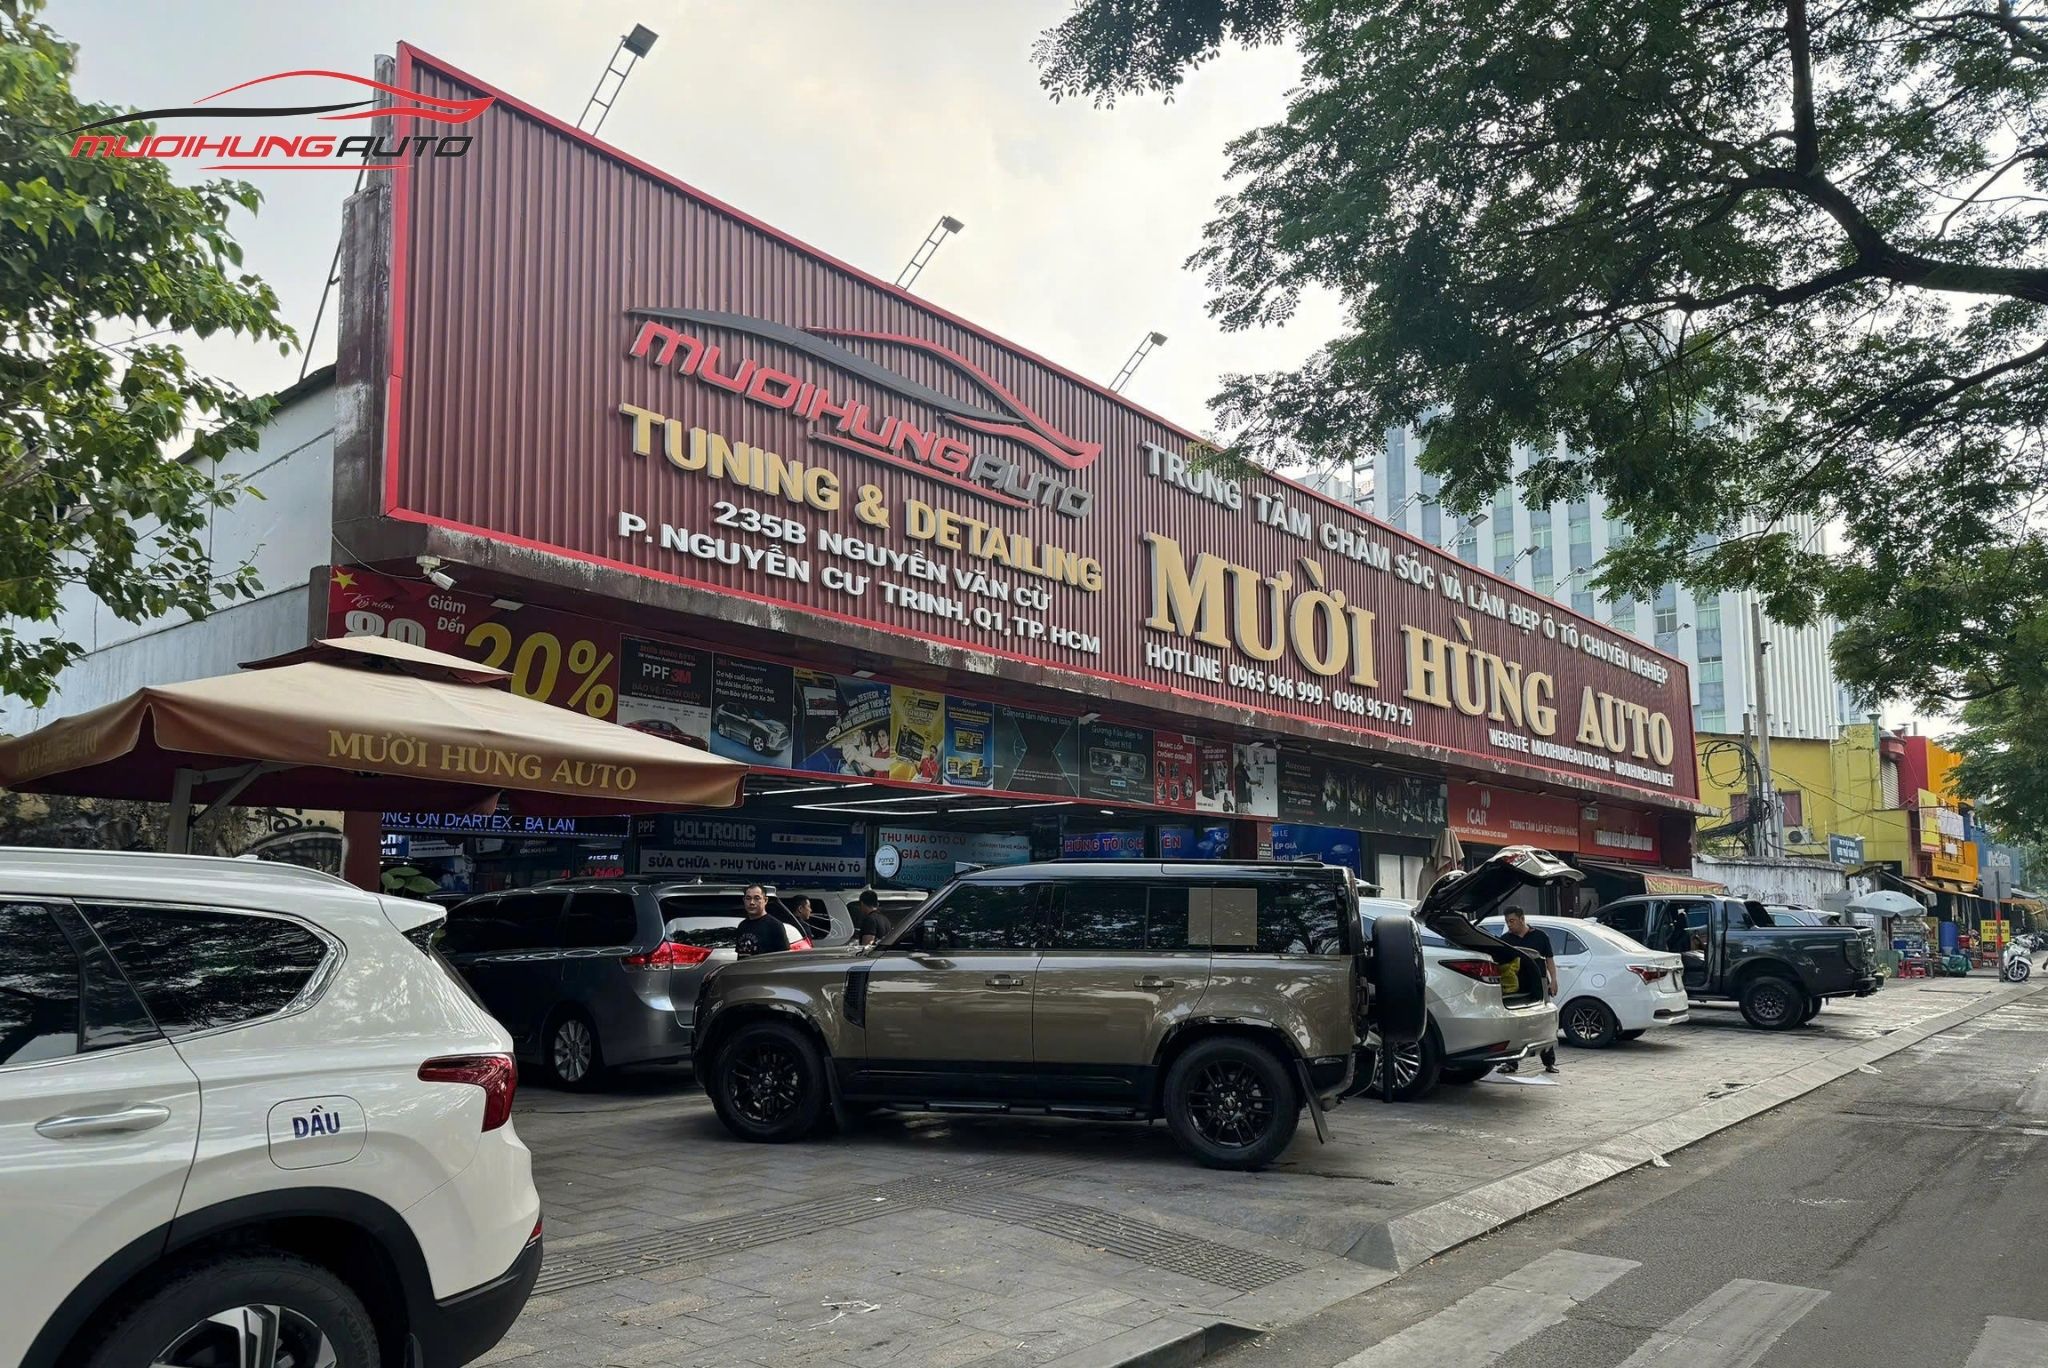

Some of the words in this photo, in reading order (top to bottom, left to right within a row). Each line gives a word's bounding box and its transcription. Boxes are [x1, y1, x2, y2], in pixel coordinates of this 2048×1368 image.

[618, 403, 839, 512] TUNING
[855, 484, 891, 528] &
[905, 499, 1102, 592] DETAILING
[660, 523, 810, 583] NGUYỄN
[821, 566, 870, 596] CƯ
[712, 501, 807, 545] 235B
[817, 529, 947, 585] NGUYỄN
[953, 567, 1009, 602] VĂN
[1014, 583, 1054, 611] CỪ
[1142, 441, 1242, 511] TRUNG
[1252, 491, 1312, 541] TÂM
[1319, 522, 1391, 572] CHĂM
[1438, 568, 1464, 603] VÀ
[1467, 583, 1506, 620] LÀM
[1508, 603, 1540, 636] ĐẸP
[1543, 612, 1556, 639] Ô
[1558, 623, 1579, 649] TÔ
[1580, 641, 1630, 670] CHUYÊN
[1630, 660, 1669, 688] NGHIỆP
[428, 594, 467, 614] Giảm
[437, 616, 466, 635] Đến
[1143, 531, 1379, 688] MƯỜI
[1400, 616, 1557, 737] HÙNG
[1576, 685, 1674, 767] AUTO
[465, 621, 614, 719] 20%
[642, 662, 670, 680] PPF
[1228, 663, 1265, 693] 0965
[1267, 673, 1294, 700] 966
[1296, 681, 1323, 706] 999
[1333, 688, 1365, 716] 0968
[327, 729, 429, 769] MƯỜI
[440, 742, 543, 780] HÙNG
[551, 759, 637, 791] AUTO
[525, 818, 544, 830] BA
[548, 819, 576, 832] LAN
[638, 821, 656, 834] PPF
[1466, 808, 1487, 827] ICAR
[673, 820, 756, 841] VOLTRONIC
[880, 832, 902, 843] THU
[904, 834, 927, 845] MUA
[648, 853, 675, 868] SỬA
[678, 854, 711, 869] CHỮA
[721, 860, 744, 872] PHỤ
[746, 856, 776, 871] TÙNG
[784, 858, 807, 872] MÁY
[808, 861, 837, 875] LẠNH
[838, 860, 846, 873] Ô
[848, 860, 861, 873] TÔ
[923, 850, 948, 861] CAO
[292, 1105, 341, 1138] DẦU
